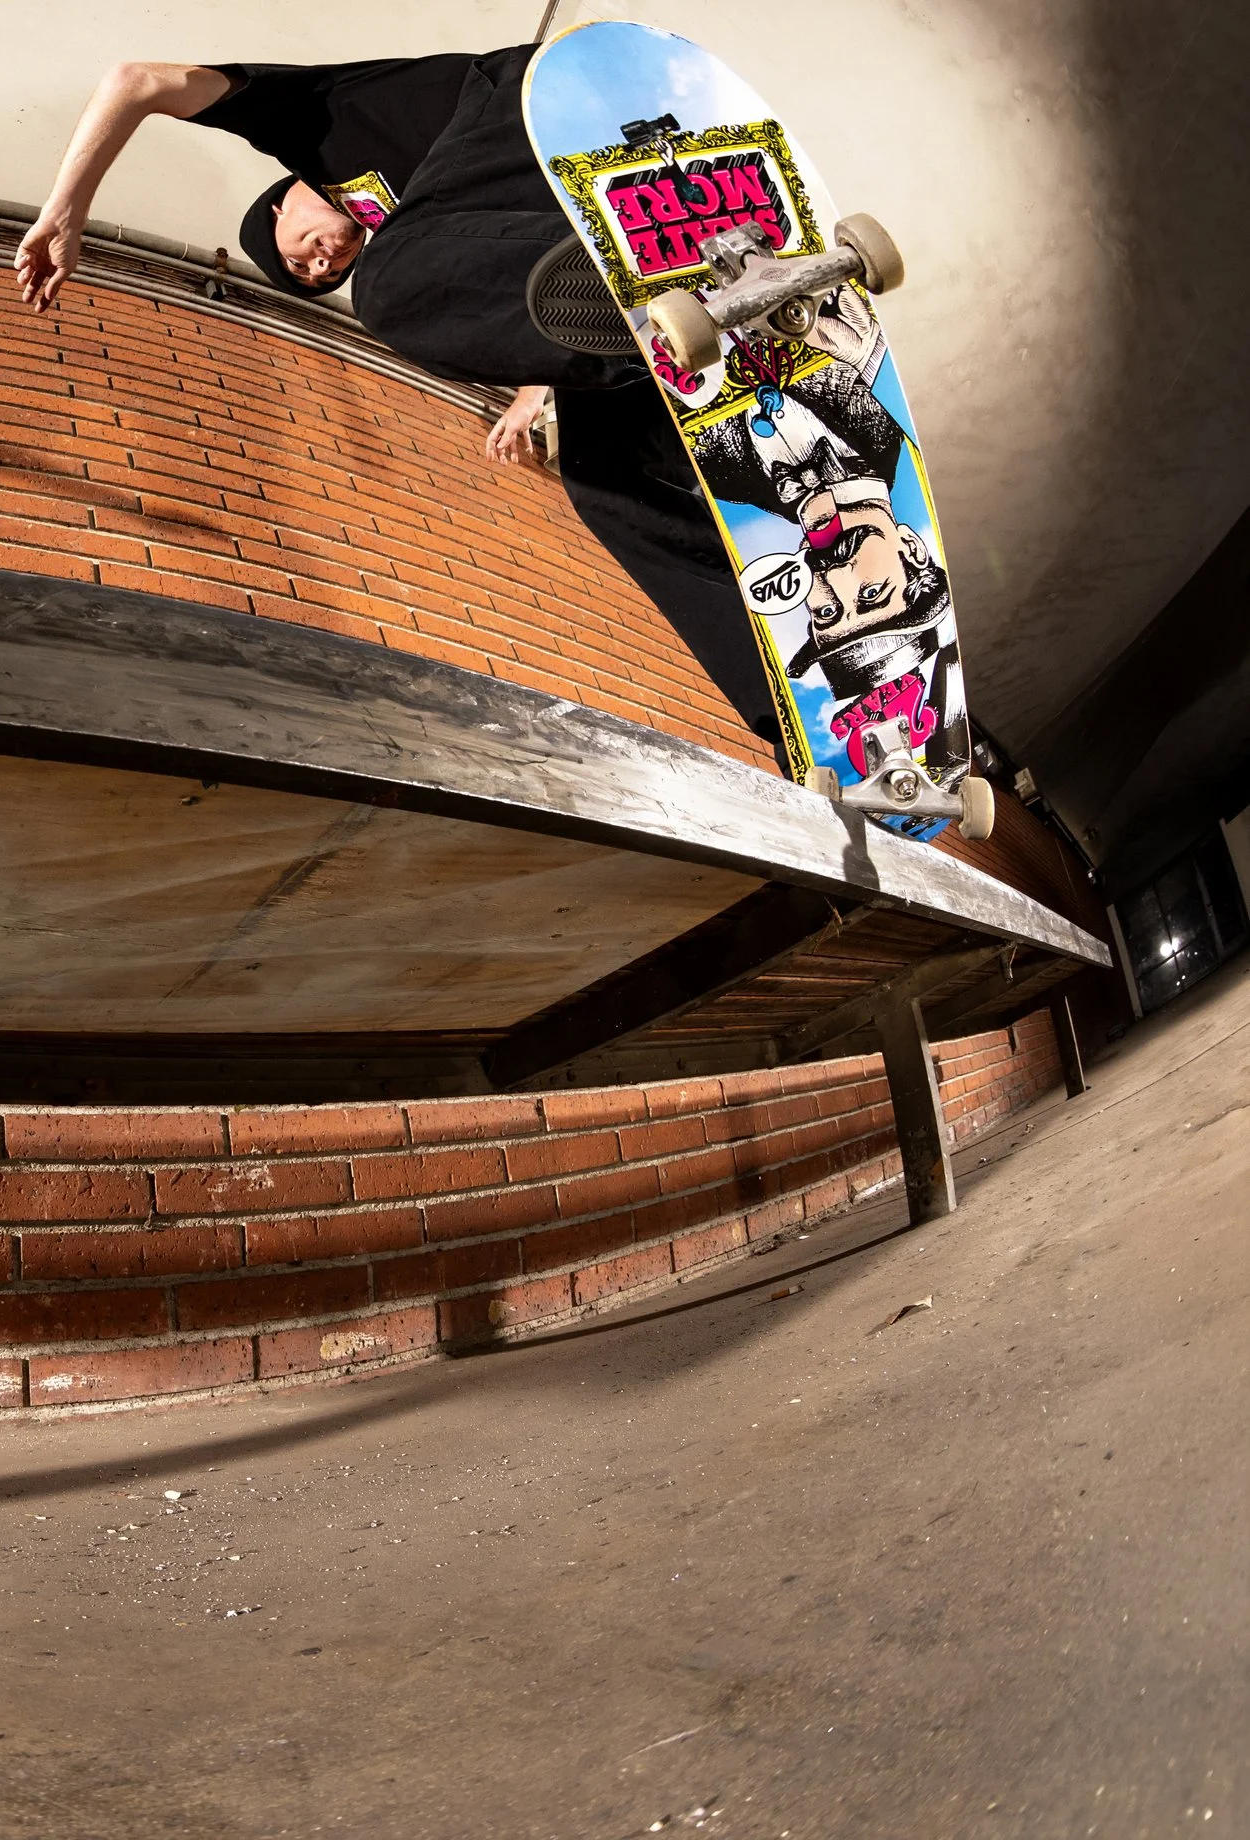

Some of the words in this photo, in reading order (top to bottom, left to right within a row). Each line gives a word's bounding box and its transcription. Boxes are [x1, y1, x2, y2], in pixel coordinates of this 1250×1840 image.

[606, 163, 771, 232] MORE
[628, 207, 786, 277] STE
[829, 673, 919, 741] YEARS
